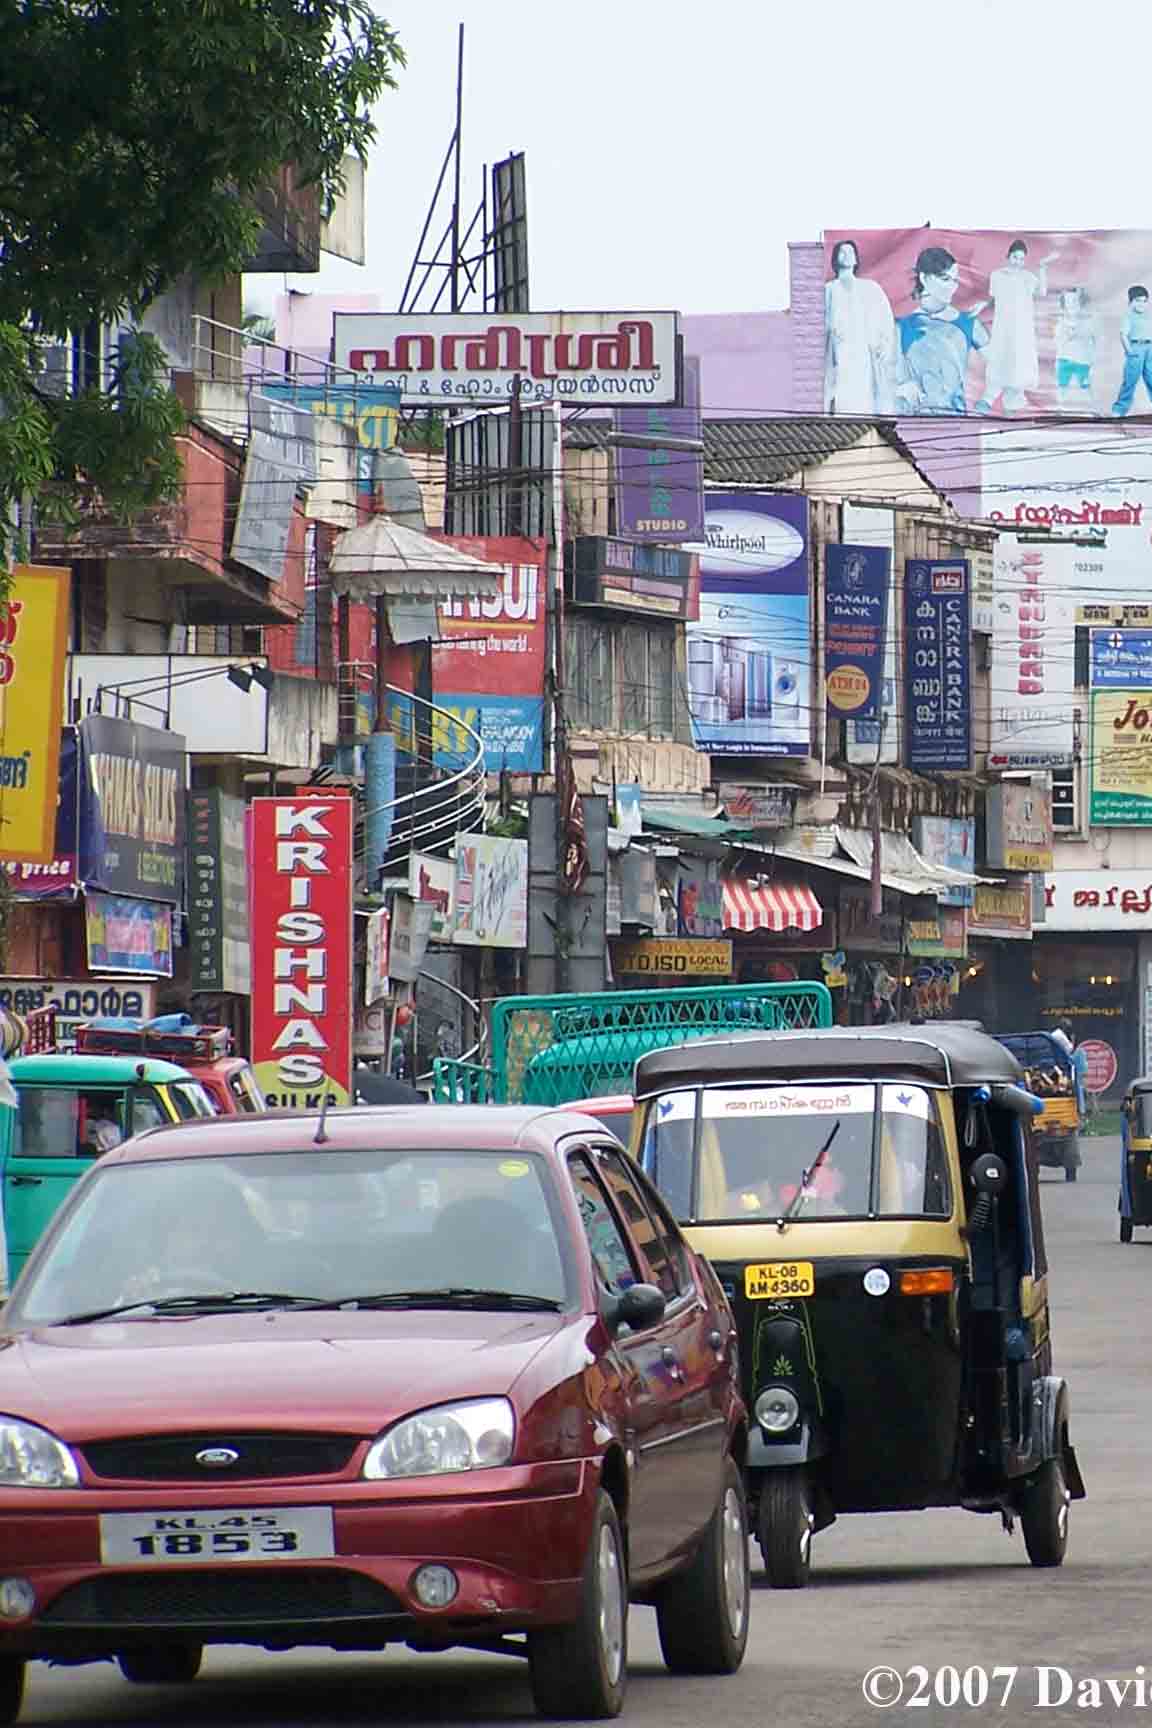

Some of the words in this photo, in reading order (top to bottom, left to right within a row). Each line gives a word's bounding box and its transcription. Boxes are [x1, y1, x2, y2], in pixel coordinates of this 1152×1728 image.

[350, 321, 659, 378] ഹരിശ്രീ
[636, 519, 687, 532] STUDIO
[705, 535, 766, 553] Whirlpool
[826, 593, 880, 606] CANARA
[833, 606, 872, 617] BANK
[945, 600, 962, 669] CANARA
[947, 674, 962, 723] BANK
[22, 859, 71, 877] price
[272, 805, 334, 1088] KRISHNAS
[758, 1265, 798, 1278] KL-08
[749, 1280, 769, 1295] AM
[133, 1531, 298, 1556] 1853
